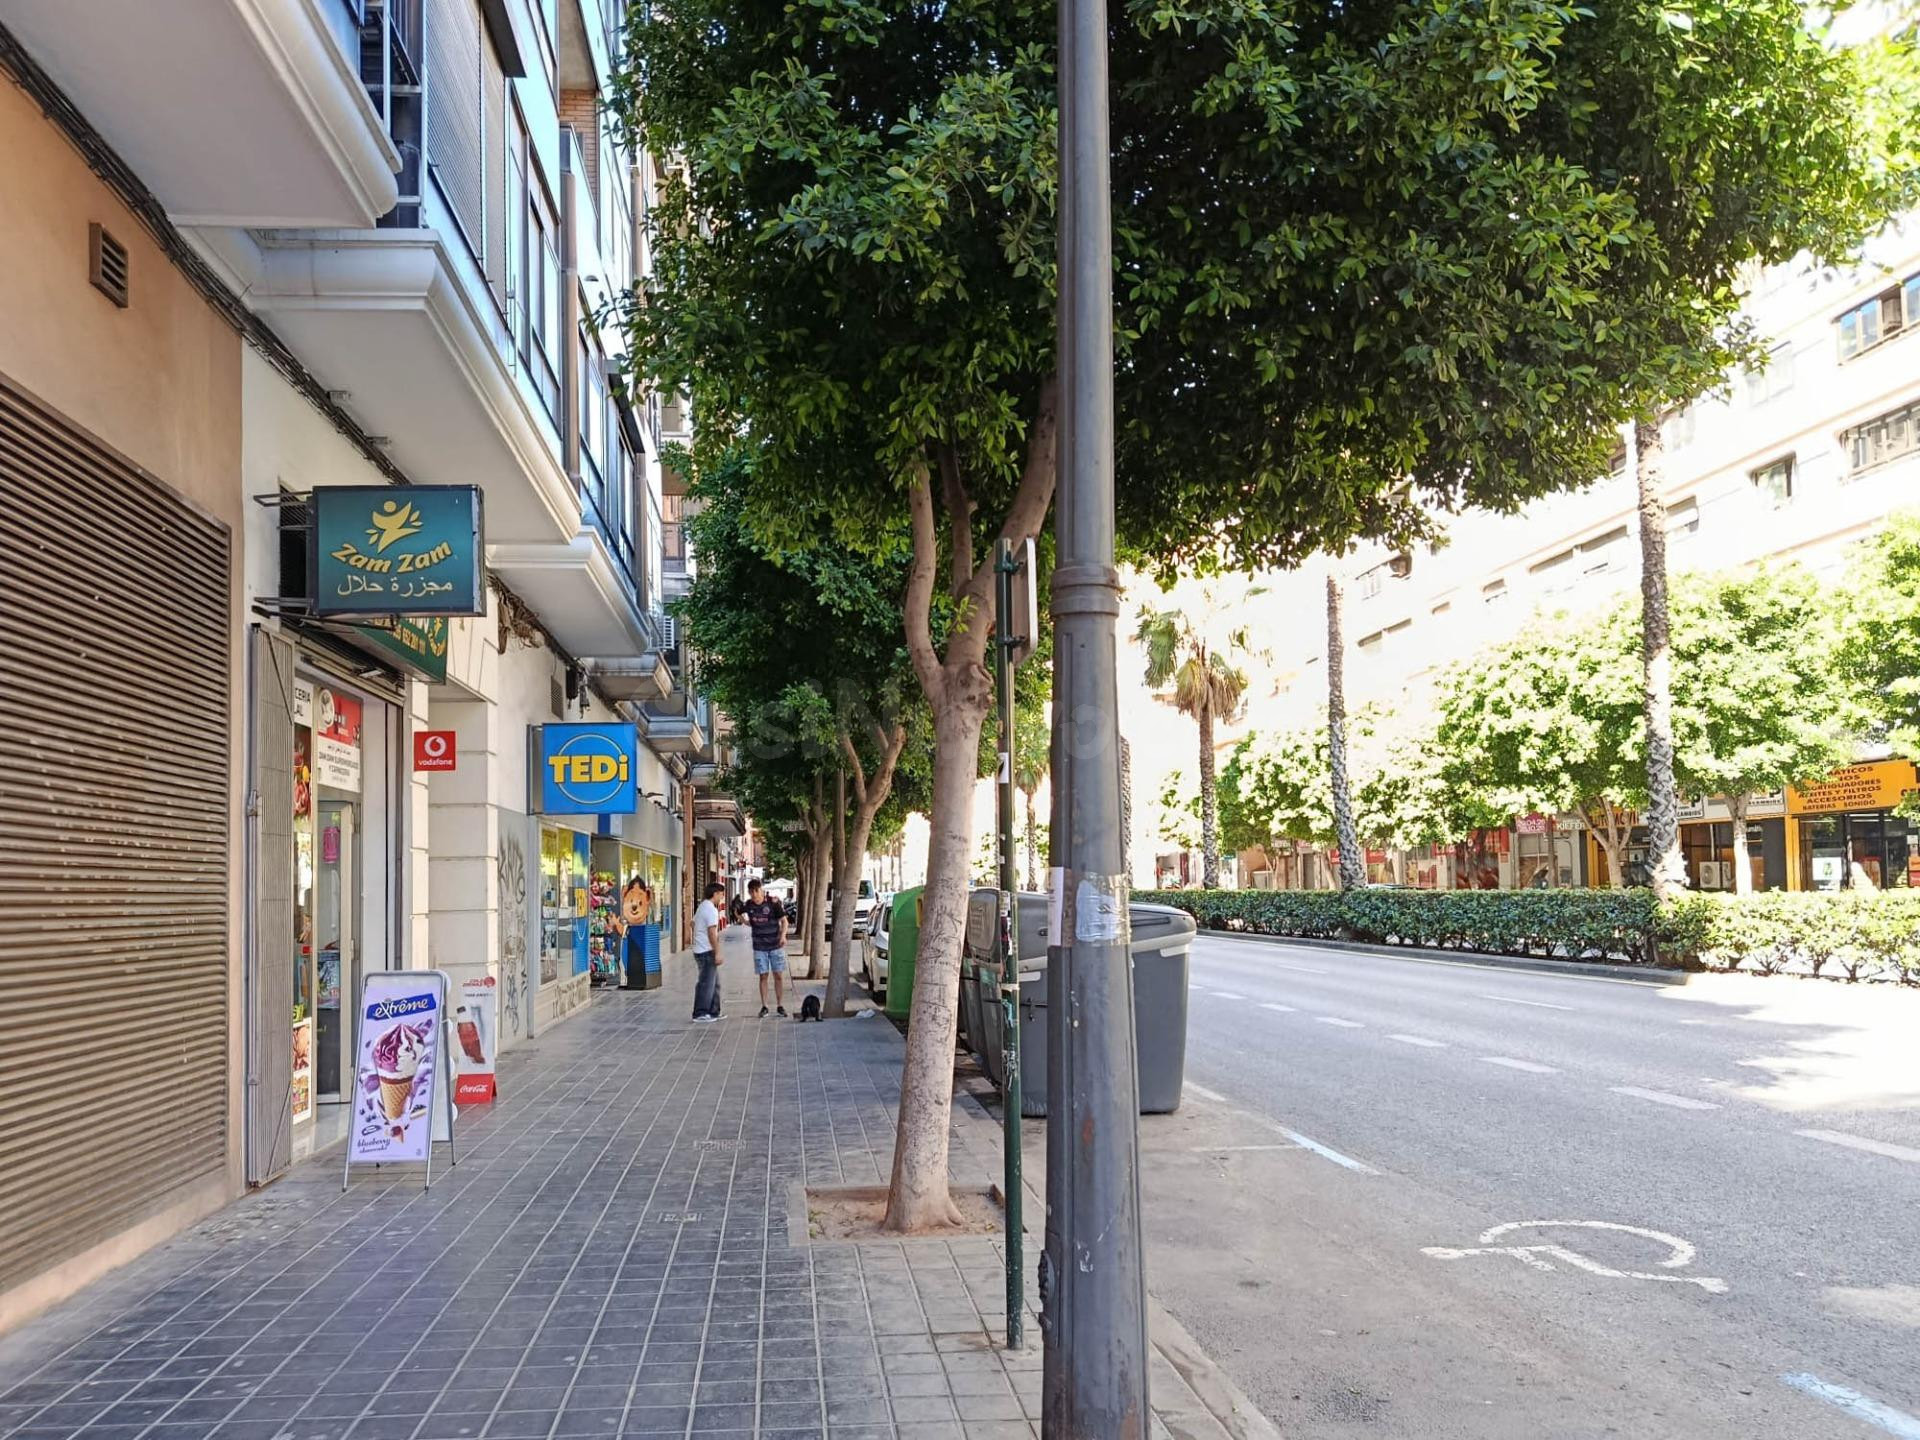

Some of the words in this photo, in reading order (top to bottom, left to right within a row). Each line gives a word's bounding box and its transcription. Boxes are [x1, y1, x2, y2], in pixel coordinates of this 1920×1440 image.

[331, 543, 391, 573] Zam
[397, 541, 452, 573] Zam
[337, 574, 384, 596] حلال
[391, 577, 453, 596] مجزرة
[418, 758, 453, 767] vodafone
[548, 755, 628, 784] TEDi
[1843, 785, 1881, 794] FILTROS
[1806, 793, 1873, 803] ACCESORIOS
[1844, 800, 1876, 808] SONIDO
